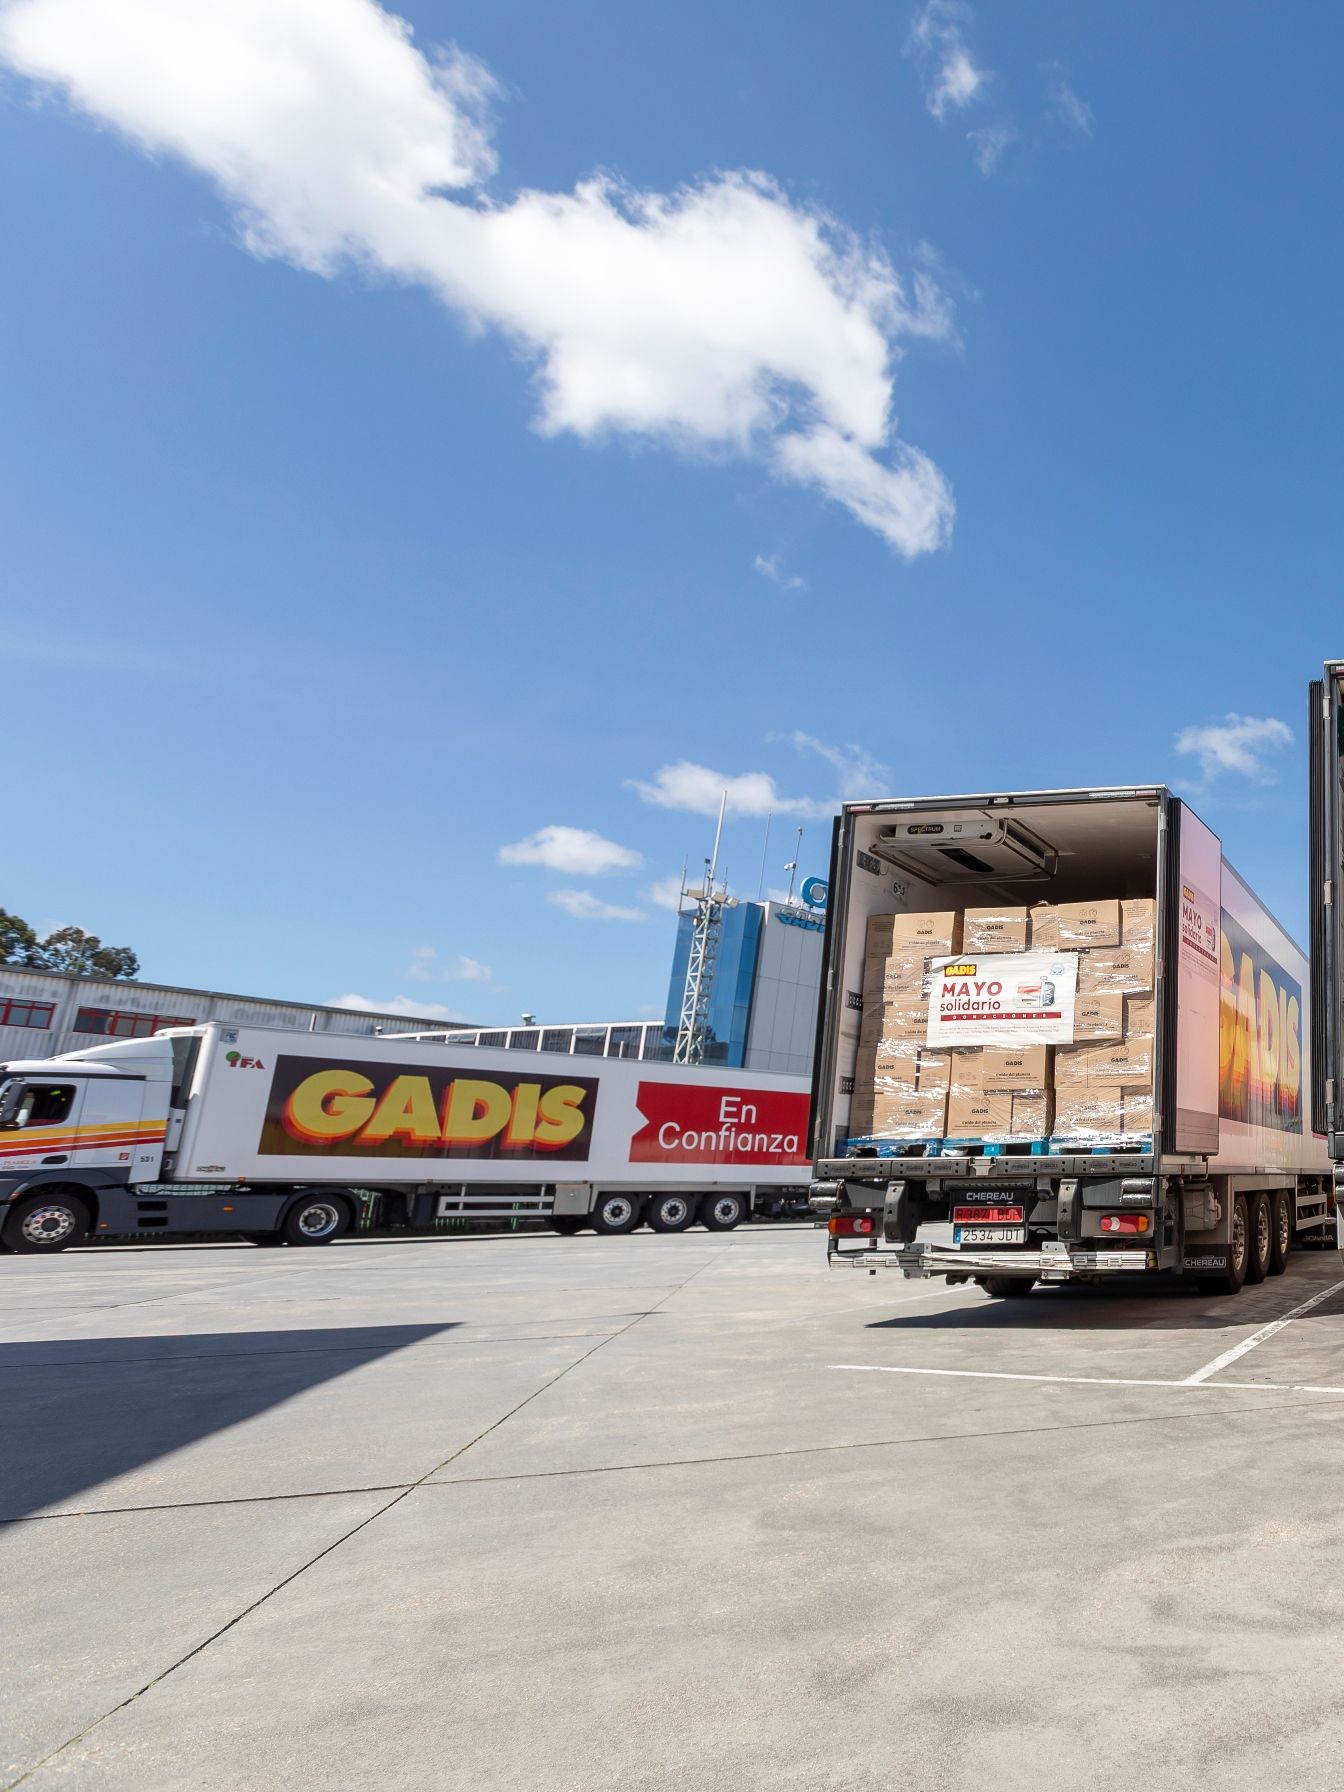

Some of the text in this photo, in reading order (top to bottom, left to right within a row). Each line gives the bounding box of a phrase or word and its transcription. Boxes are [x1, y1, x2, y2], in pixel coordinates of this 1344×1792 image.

[1182, 903, 1202, 931] MAYO
[945, 965, 976, 976] GADIS
[941, 981, 1003, 998] MAYO
[940, 998, 1001, 1012] solidario
[229, 1053, 265, 1069] IFA
[281, 1068, 588, 1152] GADIS
[719, 1096, 757, 1124] En
[658, 1121, 799, 1153] Confianza
[966, 1192, 1014, 1200] CHEREAU
[963, 1229, 1021, 1241] 2534 JDT
